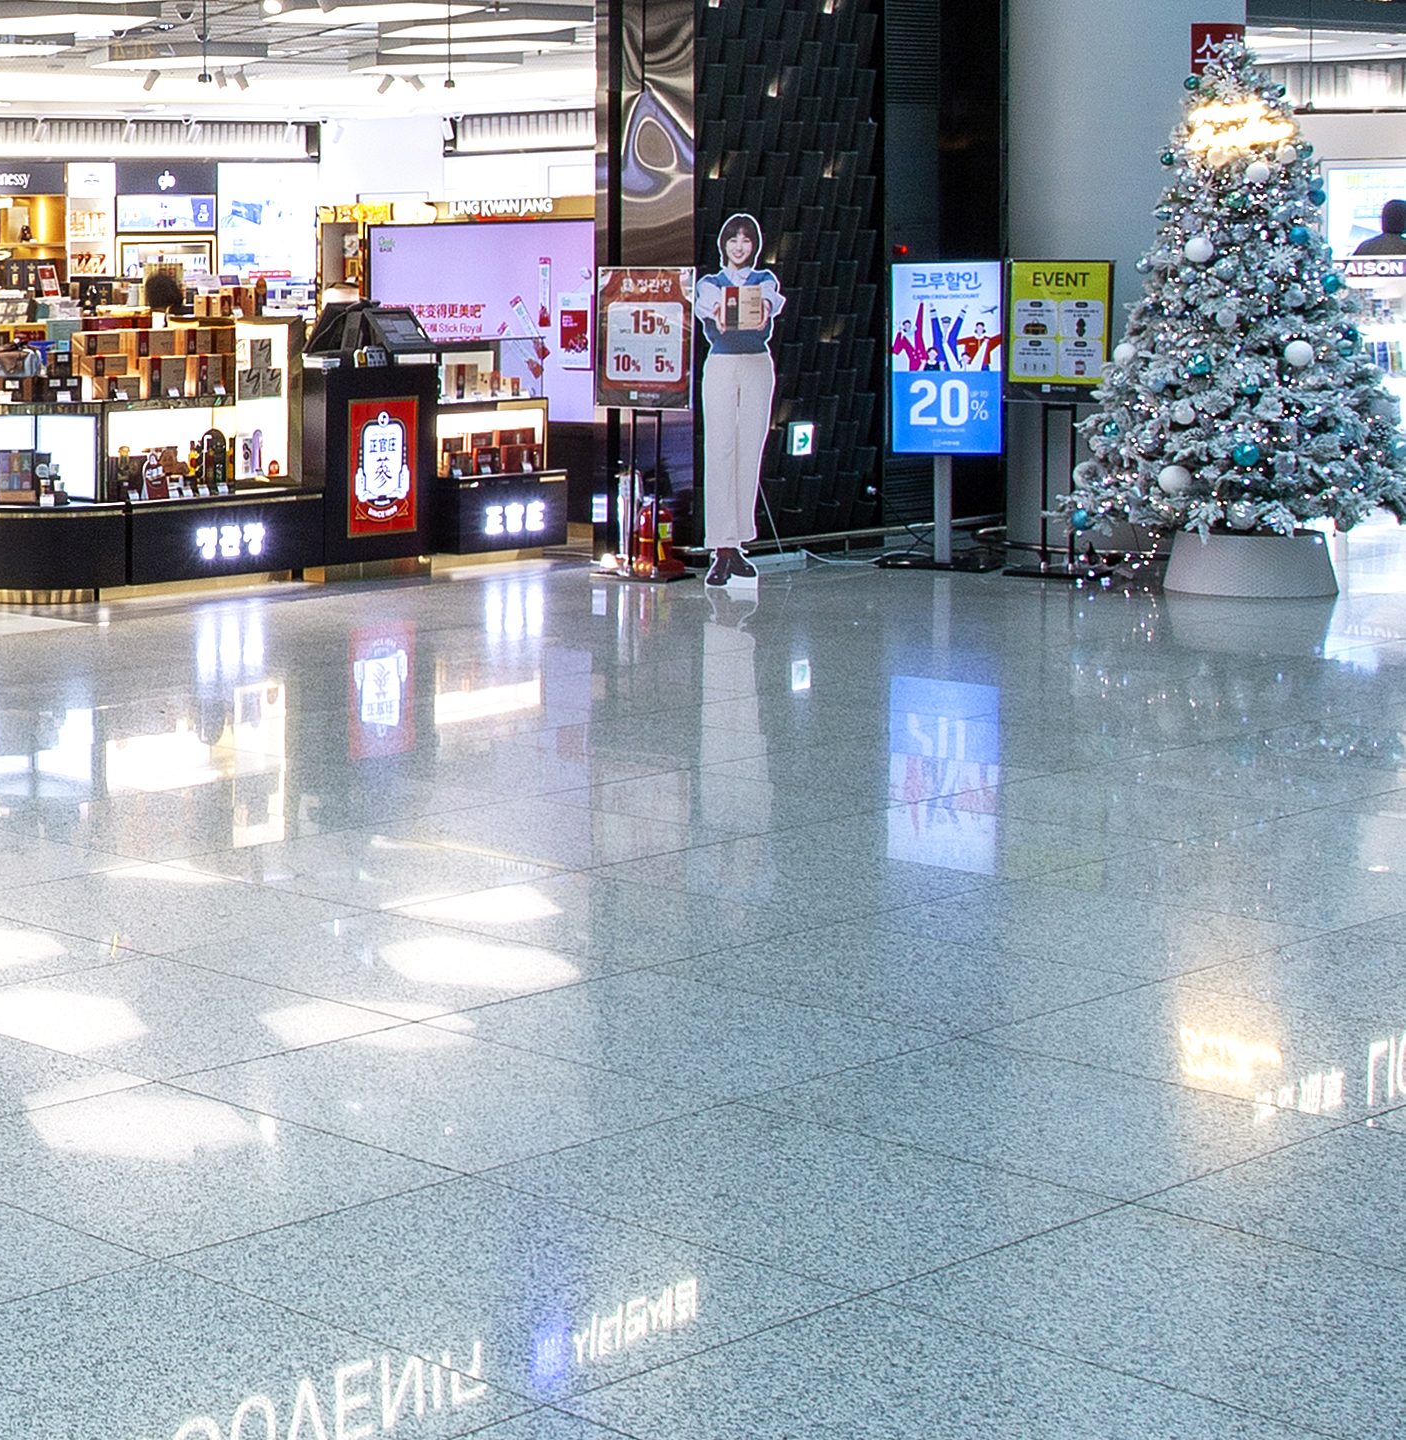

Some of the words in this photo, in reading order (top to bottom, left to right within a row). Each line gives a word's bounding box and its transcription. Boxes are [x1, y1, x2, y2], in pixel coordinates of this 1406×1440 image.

[447, 200, 480, 218] JUNG
[480, 199, 520, 217] KWAN
[518, 197, 554, 217] JANG
[636, 278, 672, 294] 정관장
[911, 271, 983, 291] 크루할인
[1032, 271, 1090, 288] EVENT
[438, 322, 458, 333] Stick
[459, 322, 483, 335] Royal
[629, 309, 670, 336] 15%
[613, 353, 641, 372] 10%
[654, 354, 675, 373] 5%
[909, 378, 969, 426] 20
